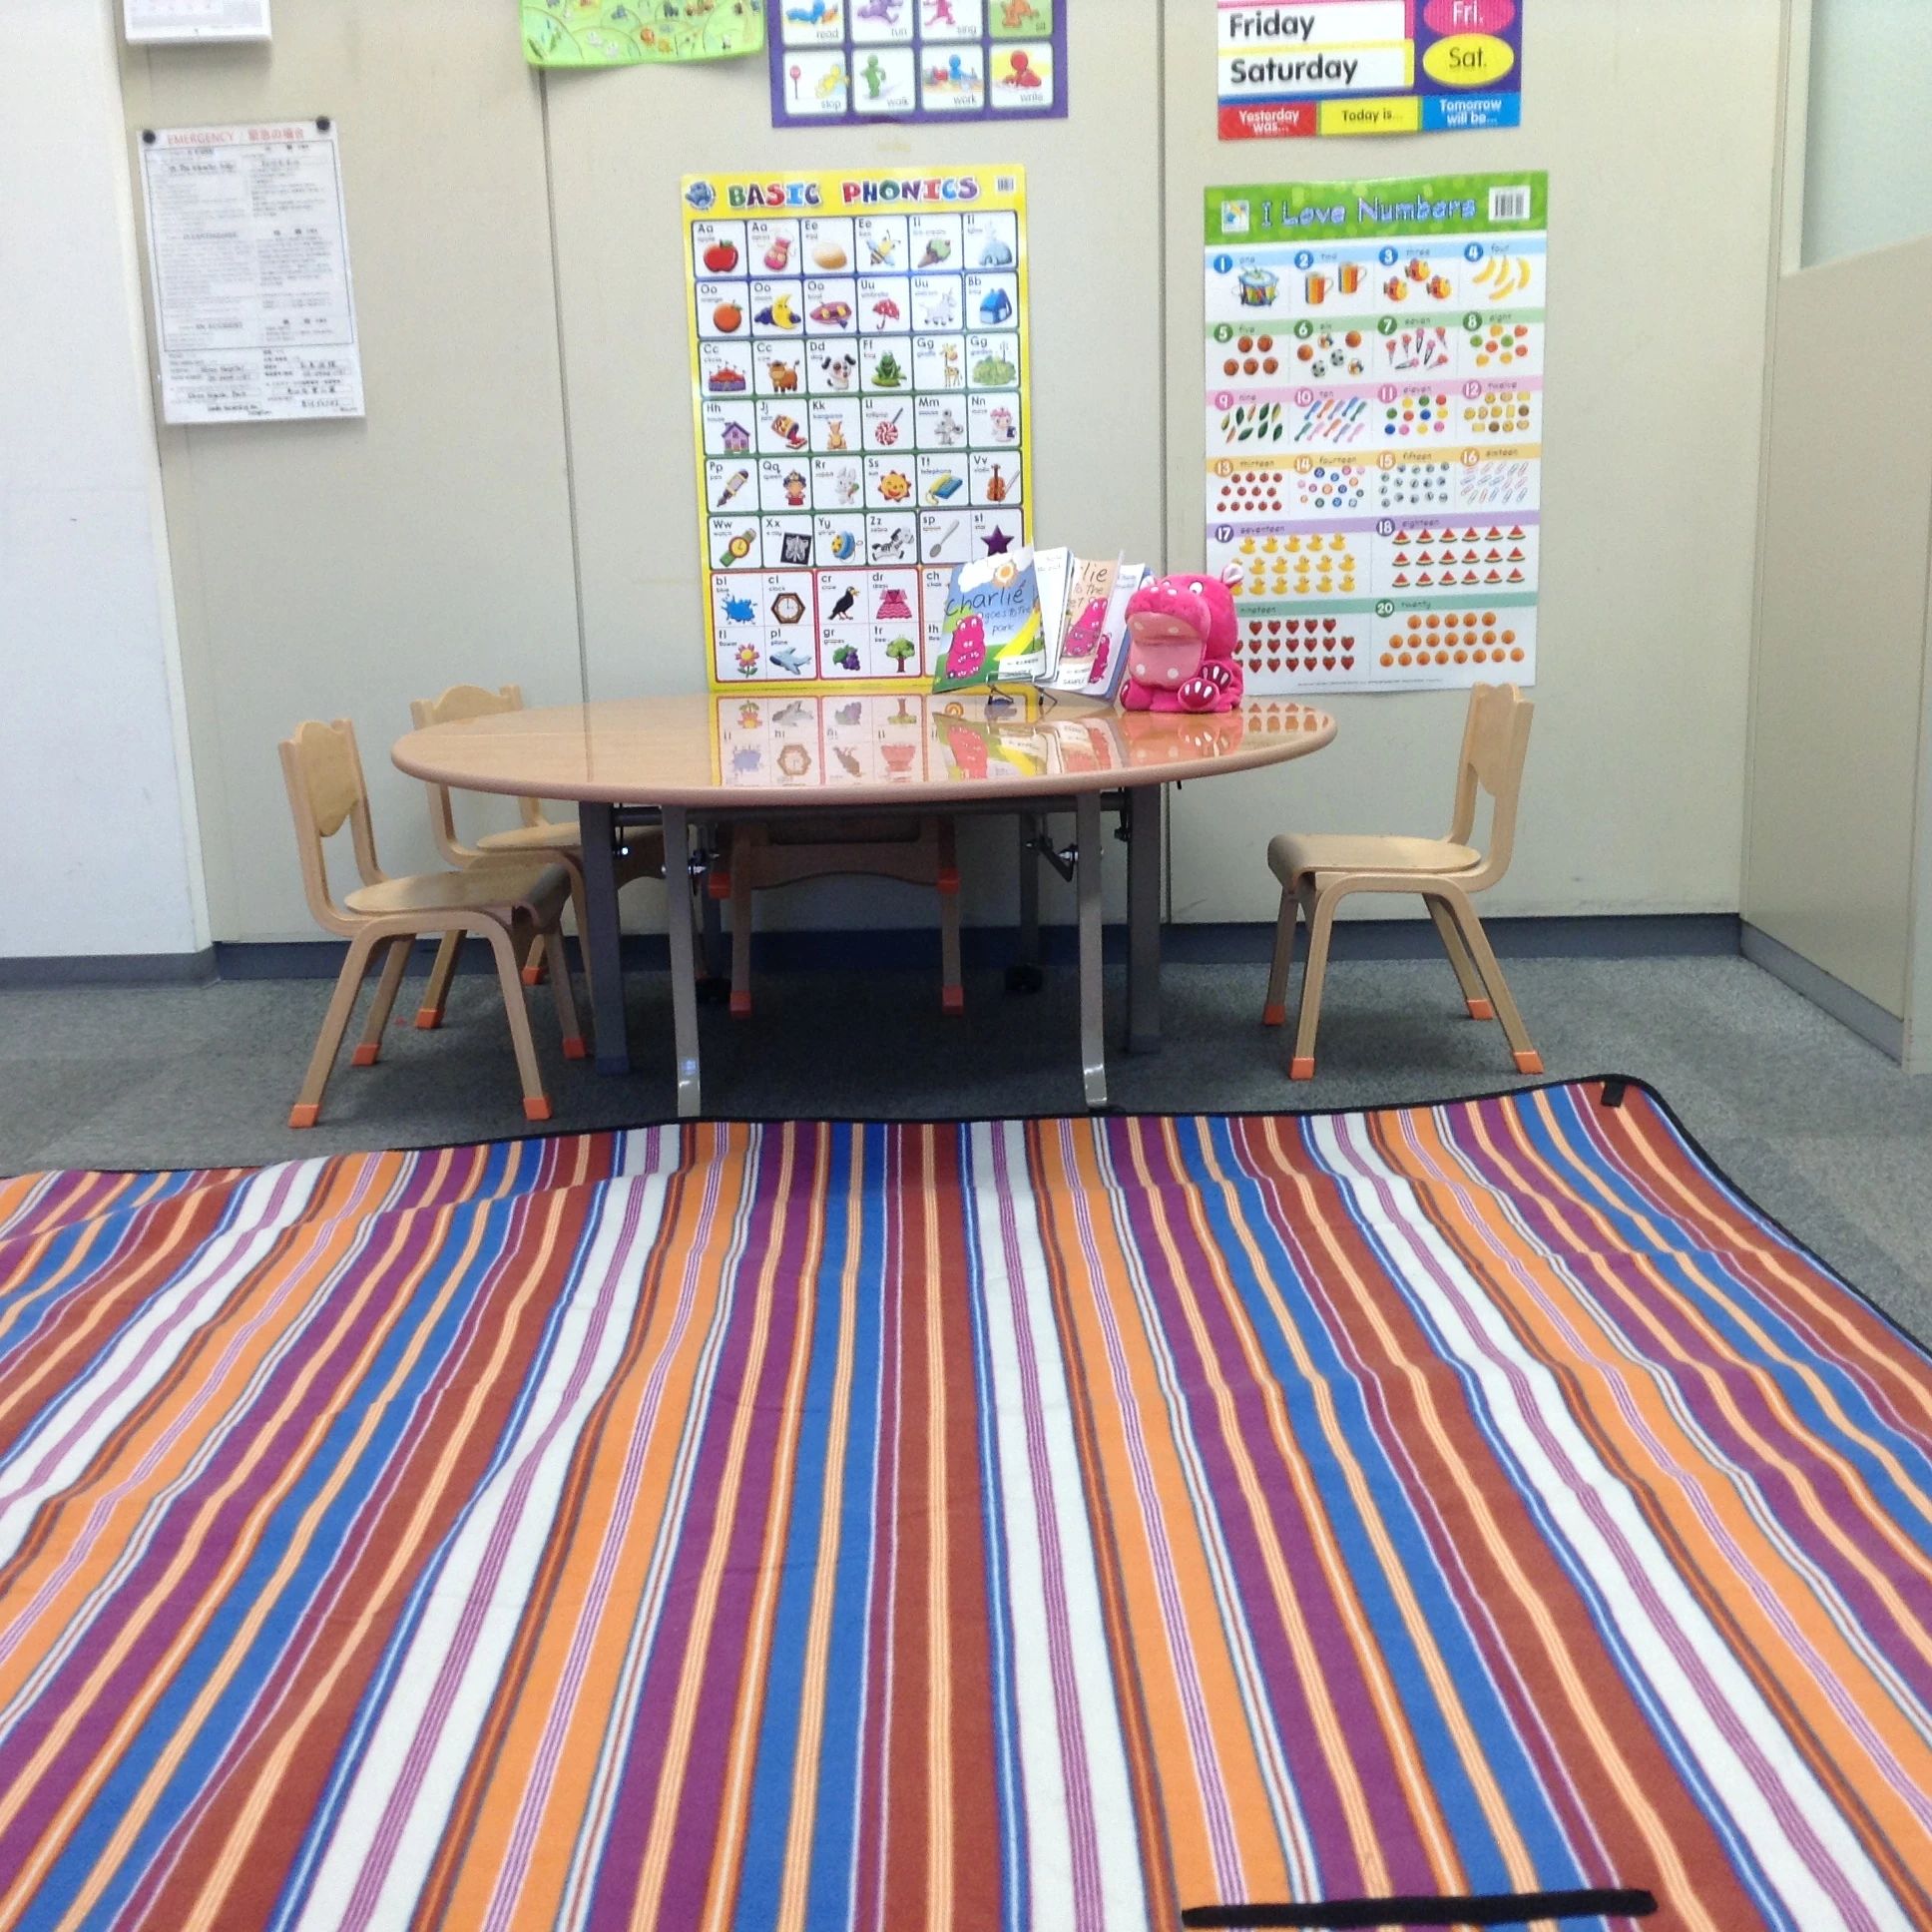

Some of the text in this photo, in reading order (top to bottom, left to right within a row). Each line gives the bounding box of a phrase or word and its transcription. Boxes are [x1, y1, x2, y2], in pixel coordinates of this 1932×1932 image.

[1452, 0, 1484, 25] Fri.
[956, 24, 977, 36] sing
[1035, 21, 1046, 32] sit
[1229, 10, 1314, 41] Friday
[816, 29, 839, 39] read
[891, 27, 908, 37] run
[1449, 47, 1488, 69] Sat.
[1230, 53, 1358, 85] Saturday
[953, 95, 977, 105] work
[1020, 91, 1044, 102] write
[820, 99, 841, 111] stop
[887, 97, 909, 107] walk
[1439, 98, 1502, 112] Tomorrow
[1238, 106, 1299, 123] Yesterday
[1341, 110, 1379, 123] Today
[1446, 113, 1472, 125] will
[727, 177, 979, 209] BASIC PHONICS
[1261, 194, 1476, 228] I Love Numbers
[699, 223, 714, 233] Aa
[751, 222, 767, 233] Aa
[804, 221, 818, 231] Ee
[858, 219, 872, 228] Ee
[861, 279, 875, 289] Uu
[915, 278, 929, 288] Uu
[968, 275, 982, 285] Bb
[701, 284, 718, 294] Oo
[754, 282, 771, 292] Oo
[807, 281, 824, 291] Oo
[810, 342, 825, 351] Dd
[917, 337, 934, 349] Gg
[971, 336, 988, 347] Gg
[704, 344, 720, 354] Cc
[756, 342, 772, 352] Cc
[813, 401, 825, 410] Kk
[919, 398, 940, 407] Mm
[972, 396, 986, 405] Nn
[707, 404, 722, 413] Hh
[815, 460, 826, 469] Rr
[868, 458, 879, 468] Ss
[974, 455, 988, 465] Vv
[710, 462, 723, 473] Pp
[762, 461, 780, 473] Qq
[870, 516, 882, 526] Zz
[923, 516, 936, 525] sp
[974, 513, 984, 522] st
[714, 520, 732, 529] Ww
[766, 518, 780, 528] Xx
[818, 517, 831, 530] Yy
[717, 576, 726, 586] bl
[768, 575, 778, 584] cl
[872, 573, 883, 582] dr
[926, 571, 940, 581] ch
[770, 629, 781, 639] pl
[823, 629, 834, 638] gr
[874, 626, 883, 635] tr
